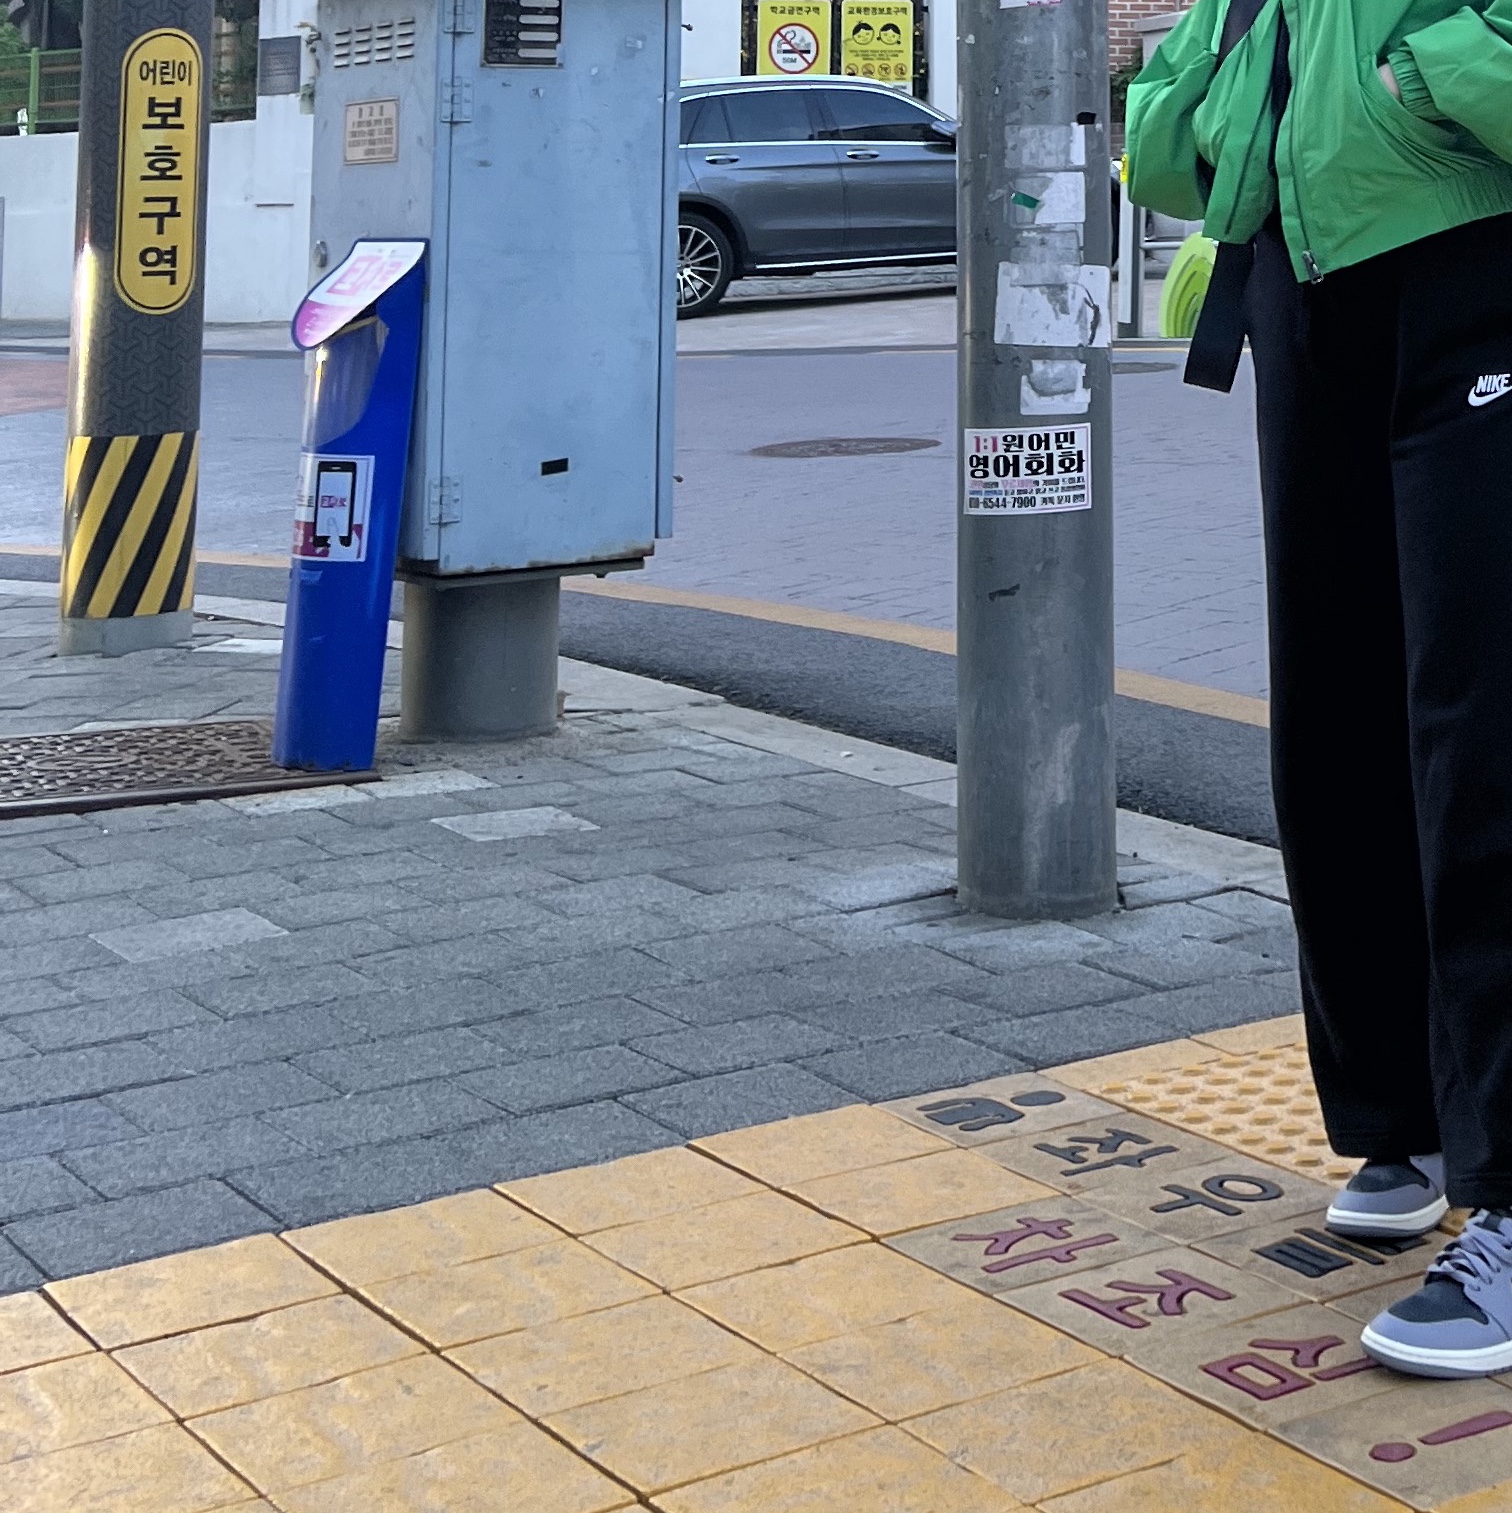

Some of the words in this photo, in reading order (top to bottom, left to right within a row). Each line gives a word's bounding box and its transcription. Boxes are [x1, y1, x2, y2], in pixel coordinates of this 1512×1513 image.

[139, 59, 192, 86] 어린이
[138, 96, 185, 286] 보호구역
[1475, 373, 1511, 394] NIKE
[975, 435, 999, 453] 1:1
[1002, 431, 1076, 453] 원어민
[969, 449, 1086, 479] 영어회화
